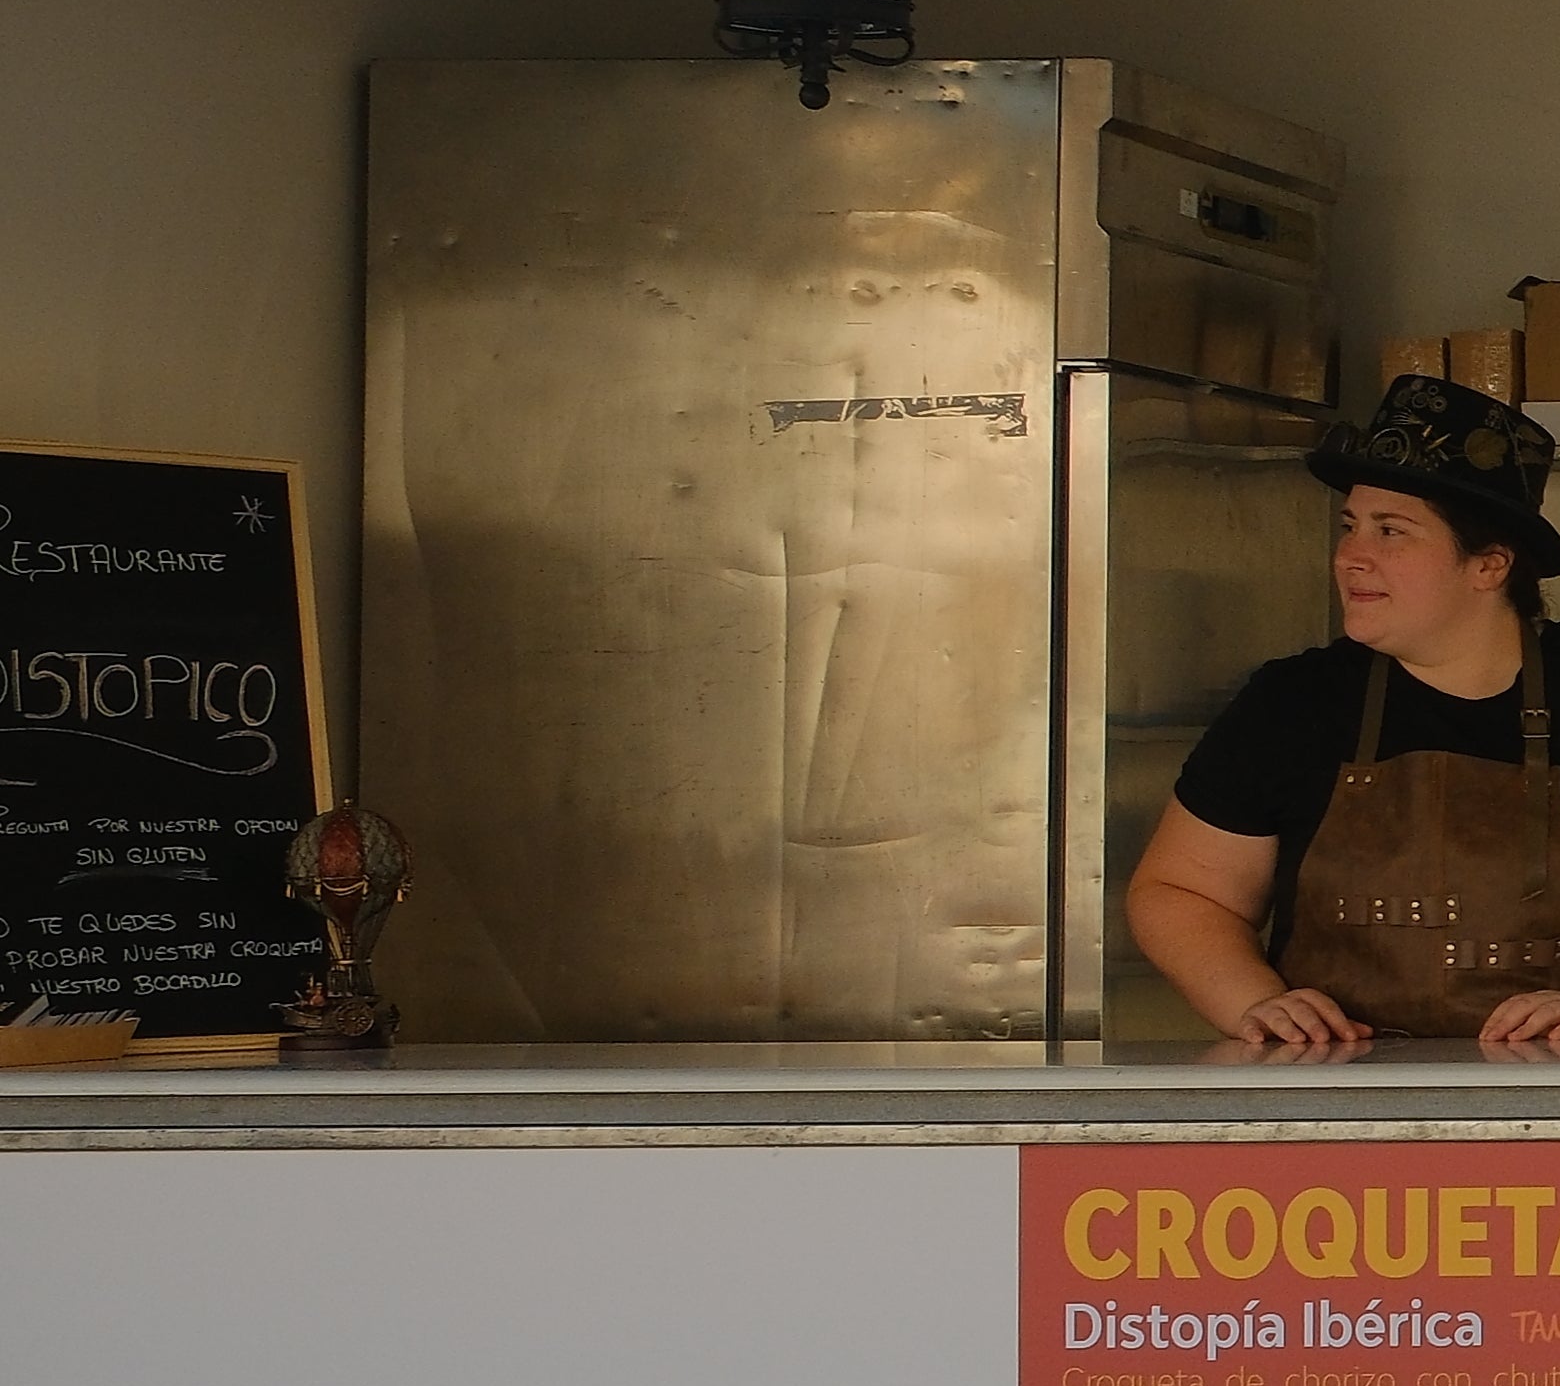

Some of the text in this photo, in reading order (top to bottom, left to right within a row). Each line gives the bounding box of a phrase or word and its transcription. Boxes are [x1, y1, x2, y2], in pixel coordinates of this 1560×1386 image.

[76, 845, 207, 866] SIN GLUTEN
[27, 916, 63, 935] TE
[78, 913, 178, 934] QUEDES
[198, 911, 236, 931] SIN
[4, 937, 323, 971] PROBAR NUESTRA CROQUETA
[30, 977, 121, 997] NUESTRO
[132, 972, 242, 996] BOCADILLO
[1064, 1298, 1287, 1362] Distopía
[1303, 1297, 1484, 1349] Ibérica
